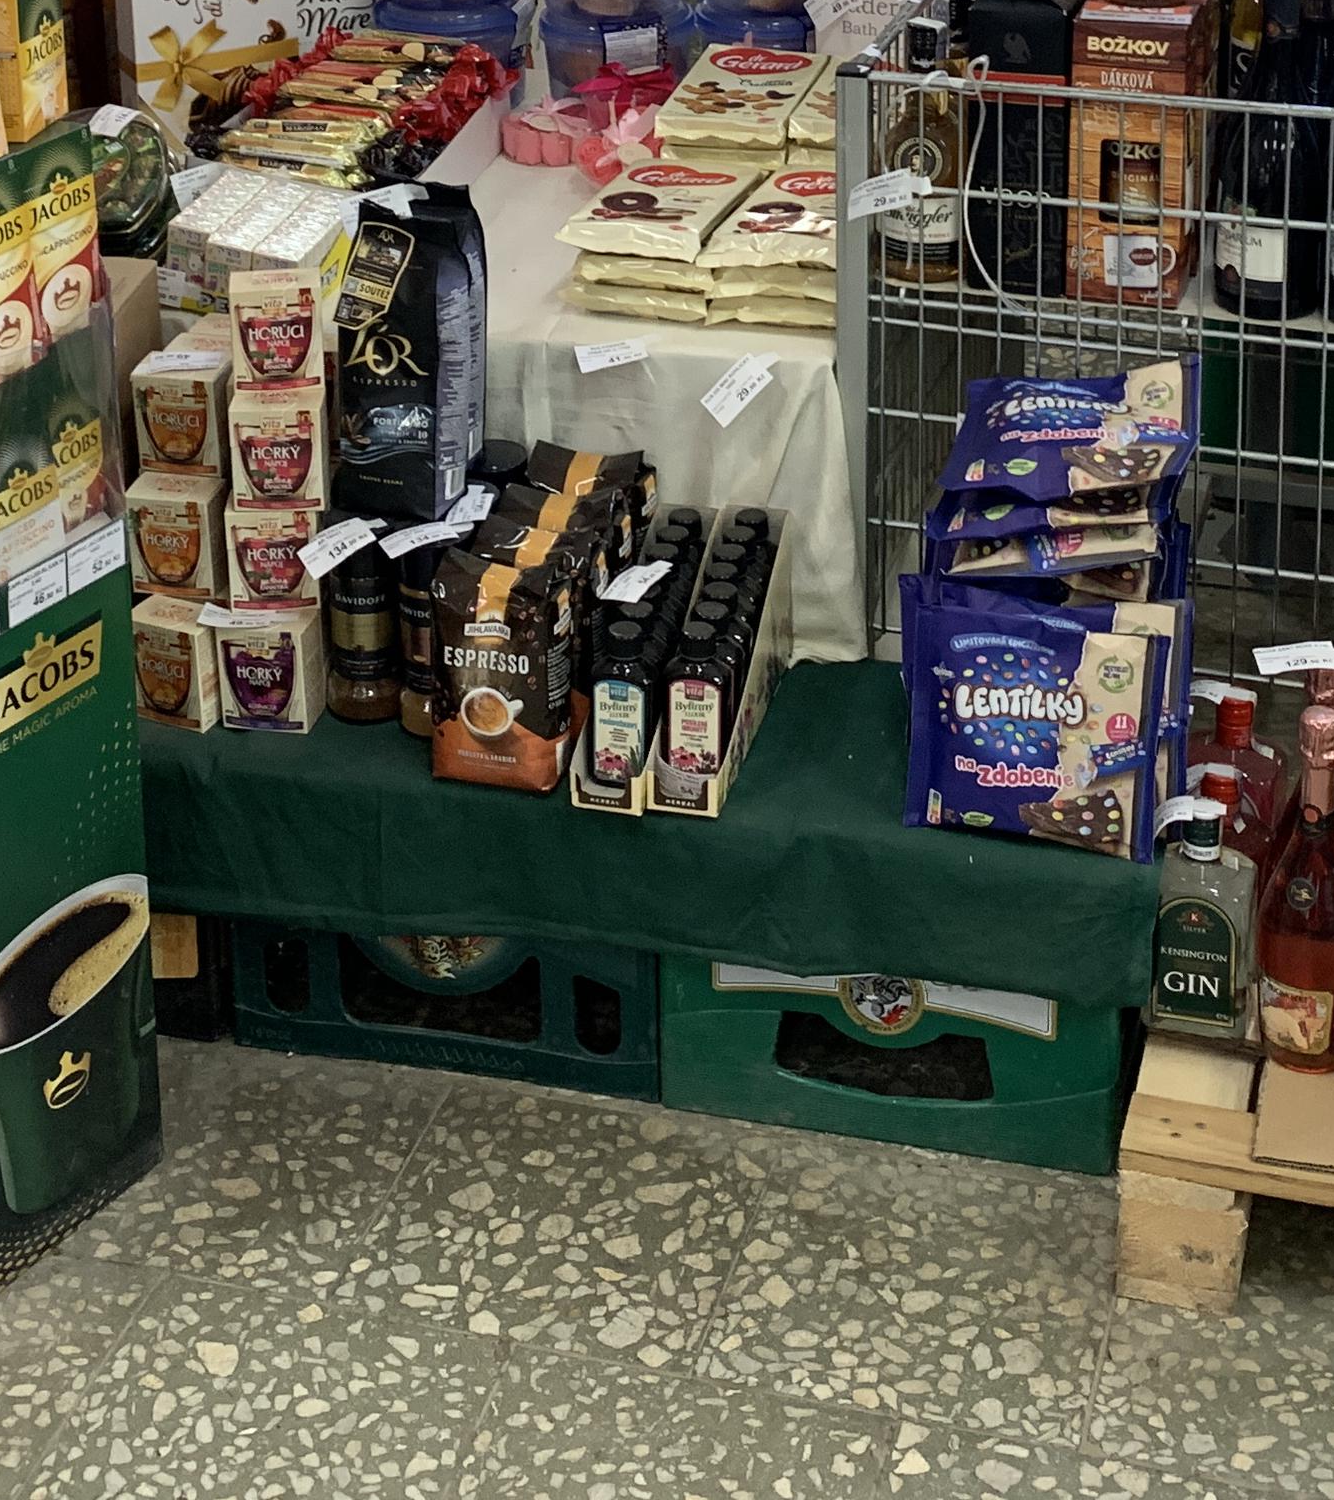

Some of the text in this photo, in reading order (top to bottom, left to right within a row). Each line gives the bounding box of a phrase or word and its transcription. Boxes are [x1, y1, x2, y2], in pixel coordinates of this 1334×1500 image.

[24, 31, 64, 70] JACOBS
[1086, 35, 1170, 57] BOŽKOV
[1100, 69, 1154, 90] DÁRKOVÁ
[29, 183, 92, 232] JACOBS
[251, 444, 301, 461] HORKÝ
[247, 545, 297, 562] HORKÝ
[443, 646, 530, 675] ESPRESSO
[11, 716, 52, 749] MAGIC
[53, 685, 99, 722] AROMA
[1115, 715, 1128, 729] 11
[1160, 945, 1228, 963] KENSINGTON
[1162, 971, 1220, 998] GIN
